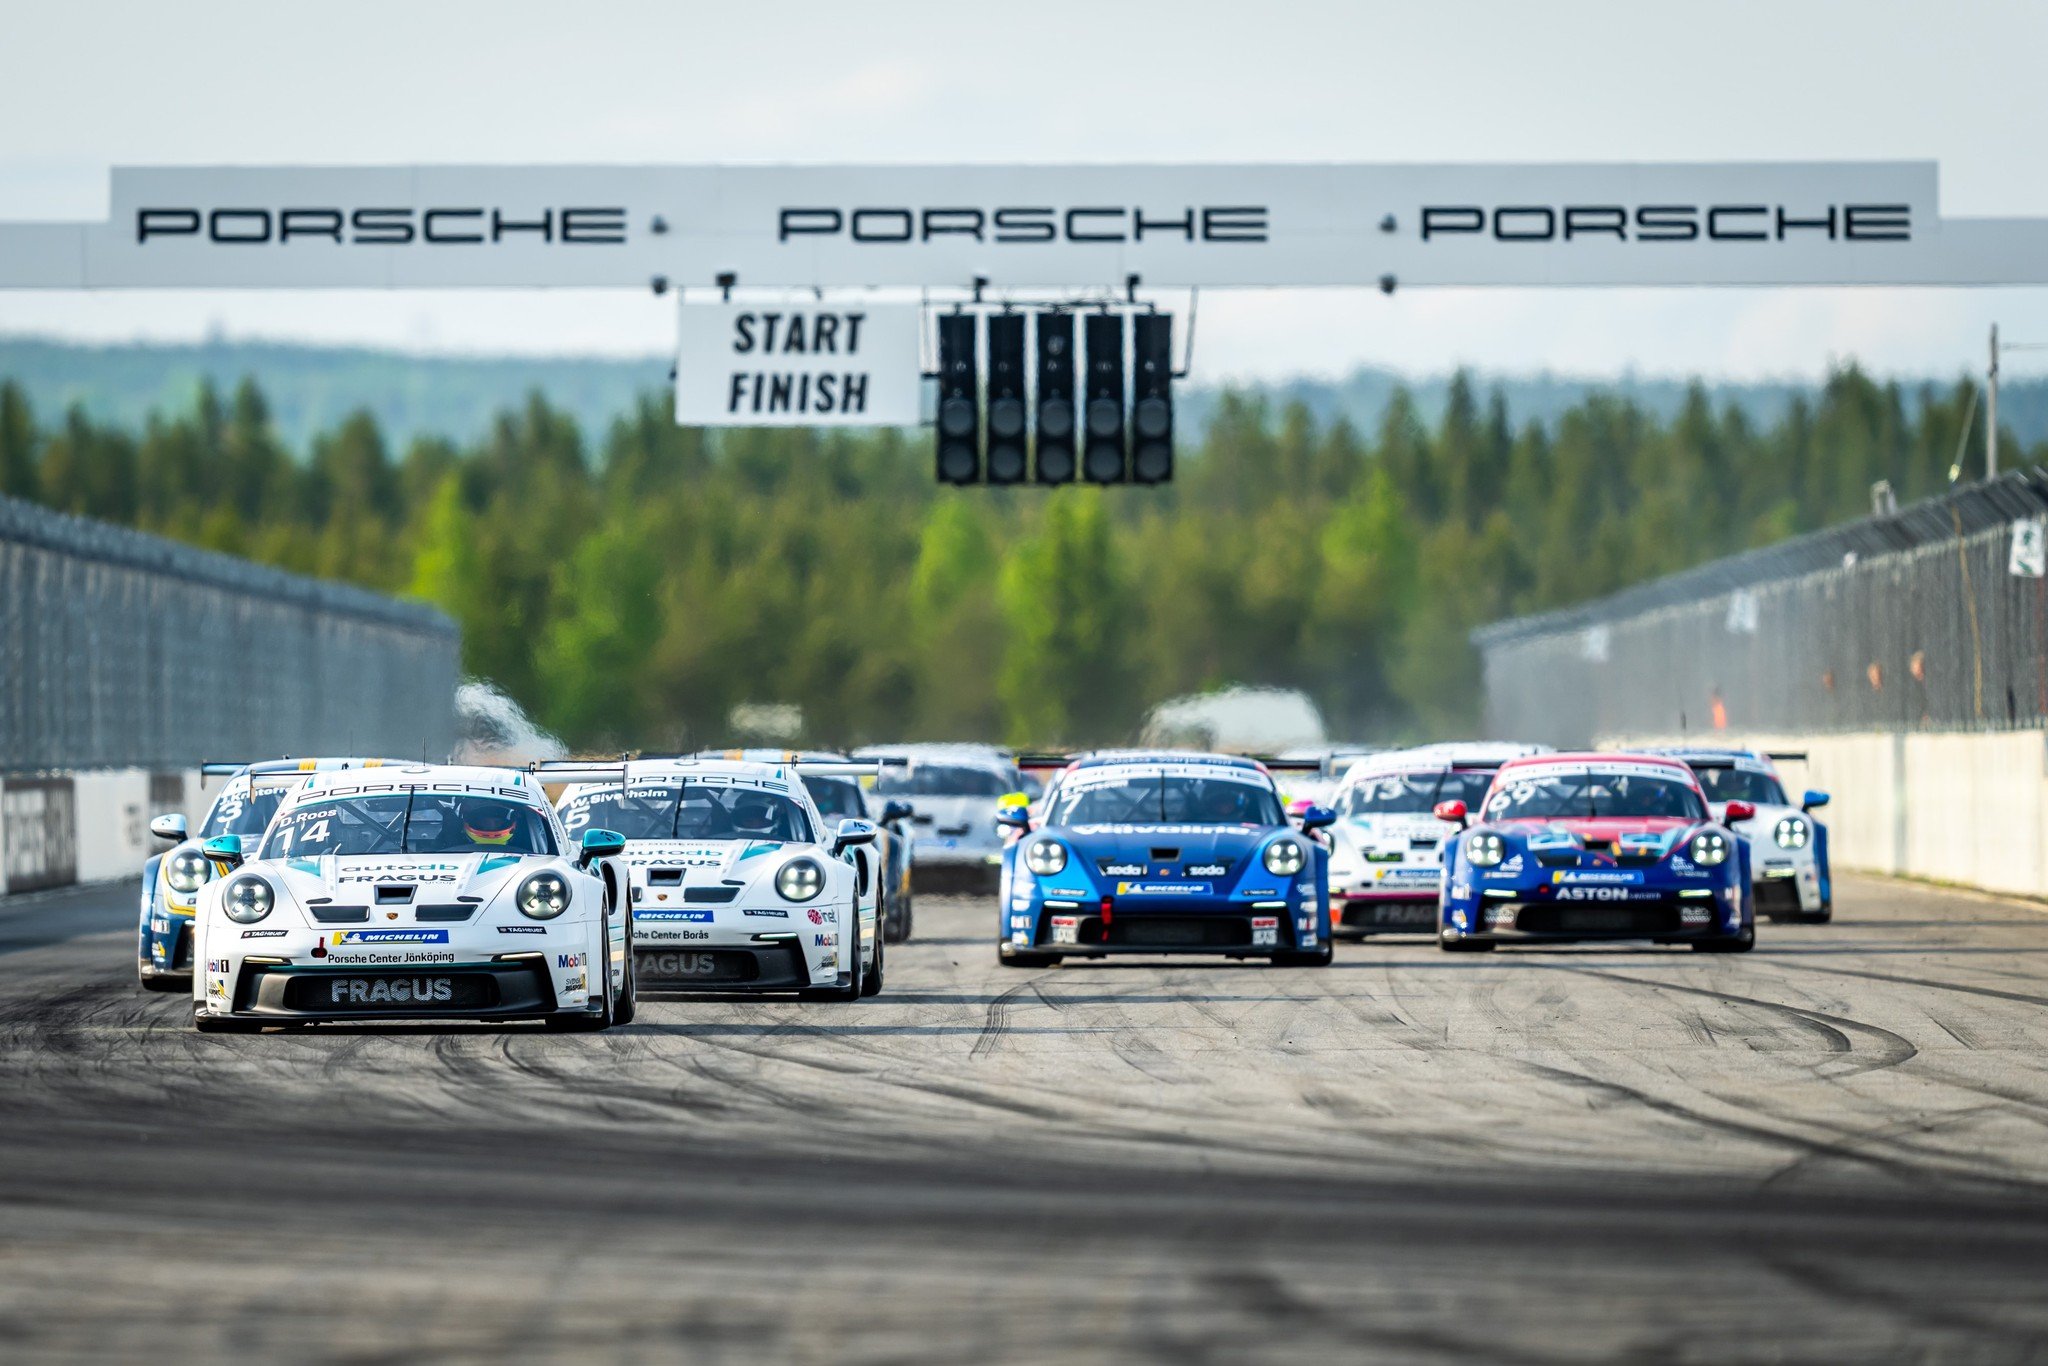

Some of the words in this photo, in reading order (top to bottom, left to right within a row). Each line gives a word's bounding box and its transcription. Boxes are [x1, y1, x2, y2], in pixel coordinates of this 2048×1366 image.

[138, 209, 624, 243] PORSCHE
[780, 208, 1266, 242] PORSCHE
[1422, 205, 1910, 241] PORSCHE
[735, 314, 863, 352] START
[730, 374, 867, 412] FINISH
[297, 783, 529, 804] PORSCHE
[217, 801, 243, 823] 3
[279, 809, 338, 829] D.Roos
[565, 806, 591, 829] 5
[275, 819, 331, 852] 14
[338, 874, 458, 884] FRAGUS
[341, 863, 460, 873] autodb
[1556, 887, 1629, 900] ASTON
[365, 933, 440, 942] MICHELIN
[651, 930, 682, 940] Center
[683, 929, 709, 940] Borås
[328, 953, 367, 964] Porsche
[369, 953, 402, 963] Center
[404, 950, 455, 964] Jönköping
[331, 978, 453, 1002] FRAGUS
